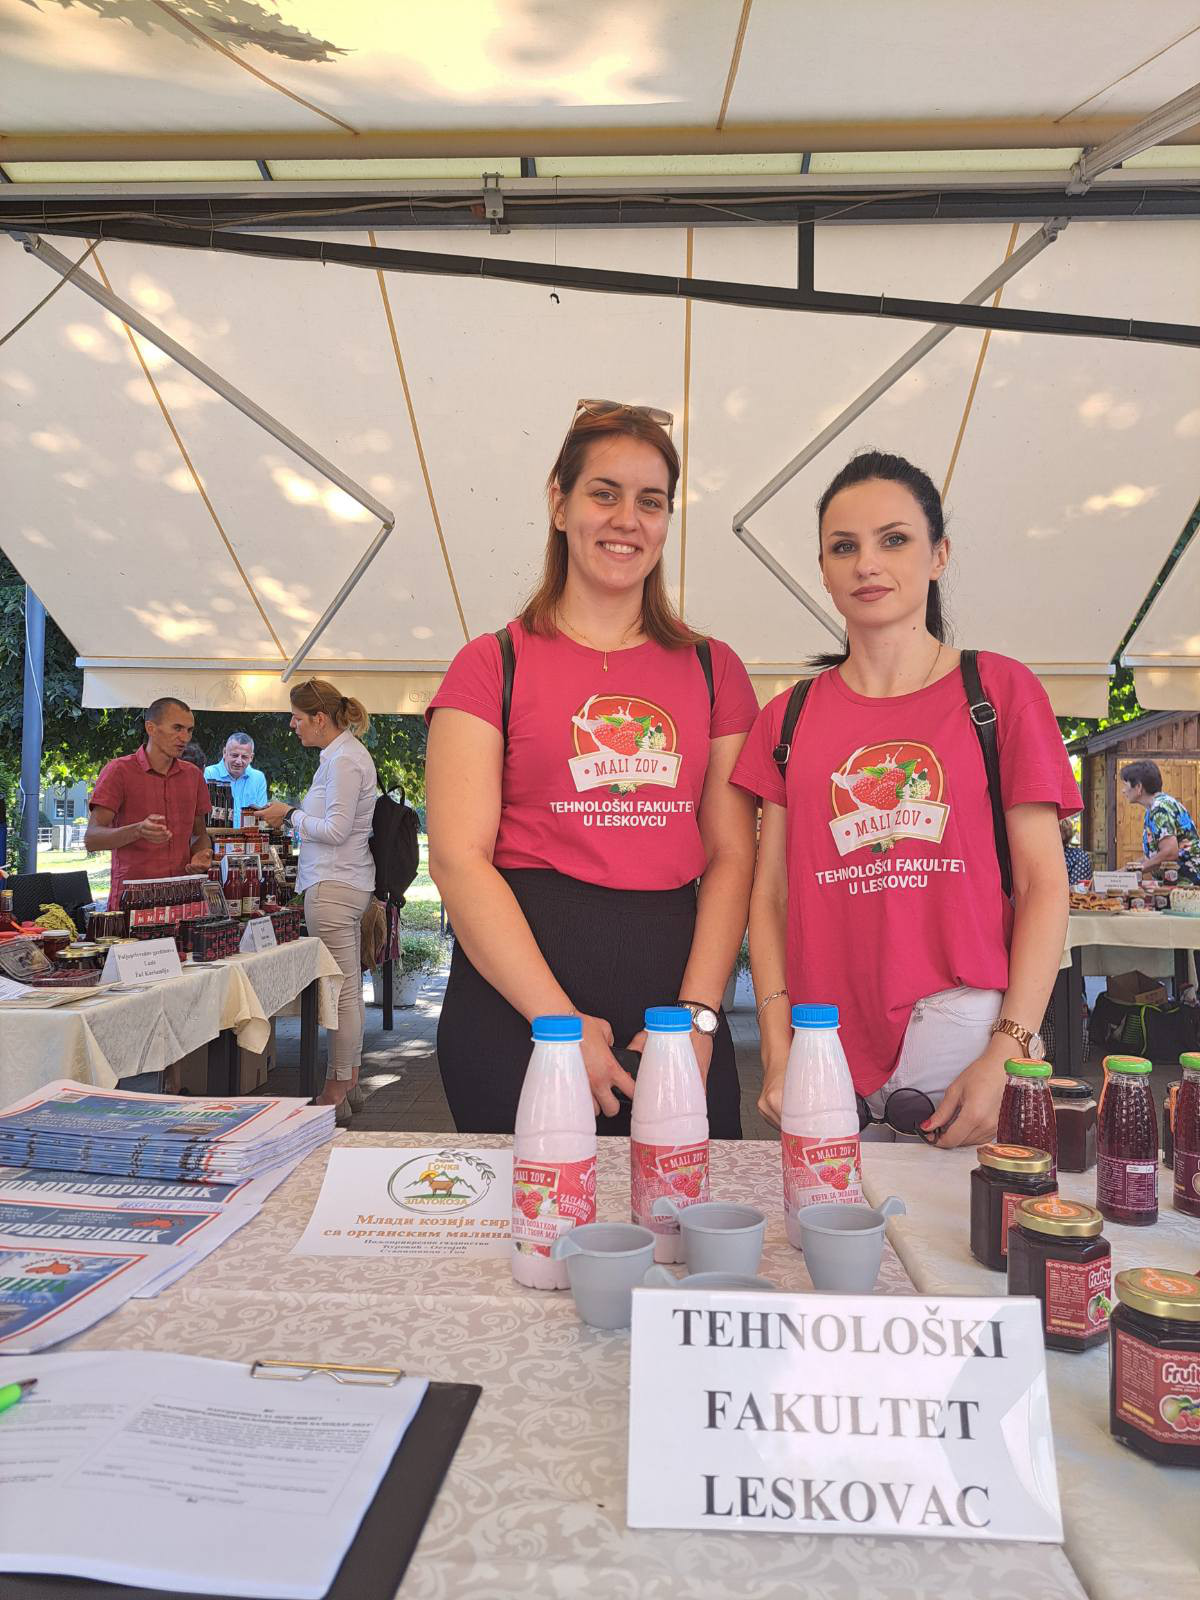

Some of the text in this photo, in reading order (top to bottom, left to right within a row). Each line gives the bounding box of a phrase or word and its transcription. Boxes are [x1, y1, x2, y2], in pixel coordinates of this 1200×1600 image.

[594, 758, 659, 777] MALI ZOV
[550, 799, 694, 813] TEHNOLOŠKI FAKULTE
[583, 815, 667, 827] U LESKOVCU
[854, 809, 921, 838] MALI ZOV
[815, 859, 892, 885] TEHNOLOŠKI
[848, 875, 928, 895] U LESKOVCU
[670, 1155, 692, 1168] MALI
[816, 1149, 837, 1160] MALI
[427, 1162, 460, 1171] Гочка
[530, 1172, 545, 1184] ZOV
[356, 1214, 415, 1228] Млади
[418, 1216, 475, 1228] козији
[479, 1217, 511, 1229] сир
[346, 1229, 441, 1239] органским
[672, 1305, 1008, 1360] TEHNOLOŠKI
[703, 1390, 980, 1440] FAKULTET
[701, 1475, 992, 1530] LESKOVAC
